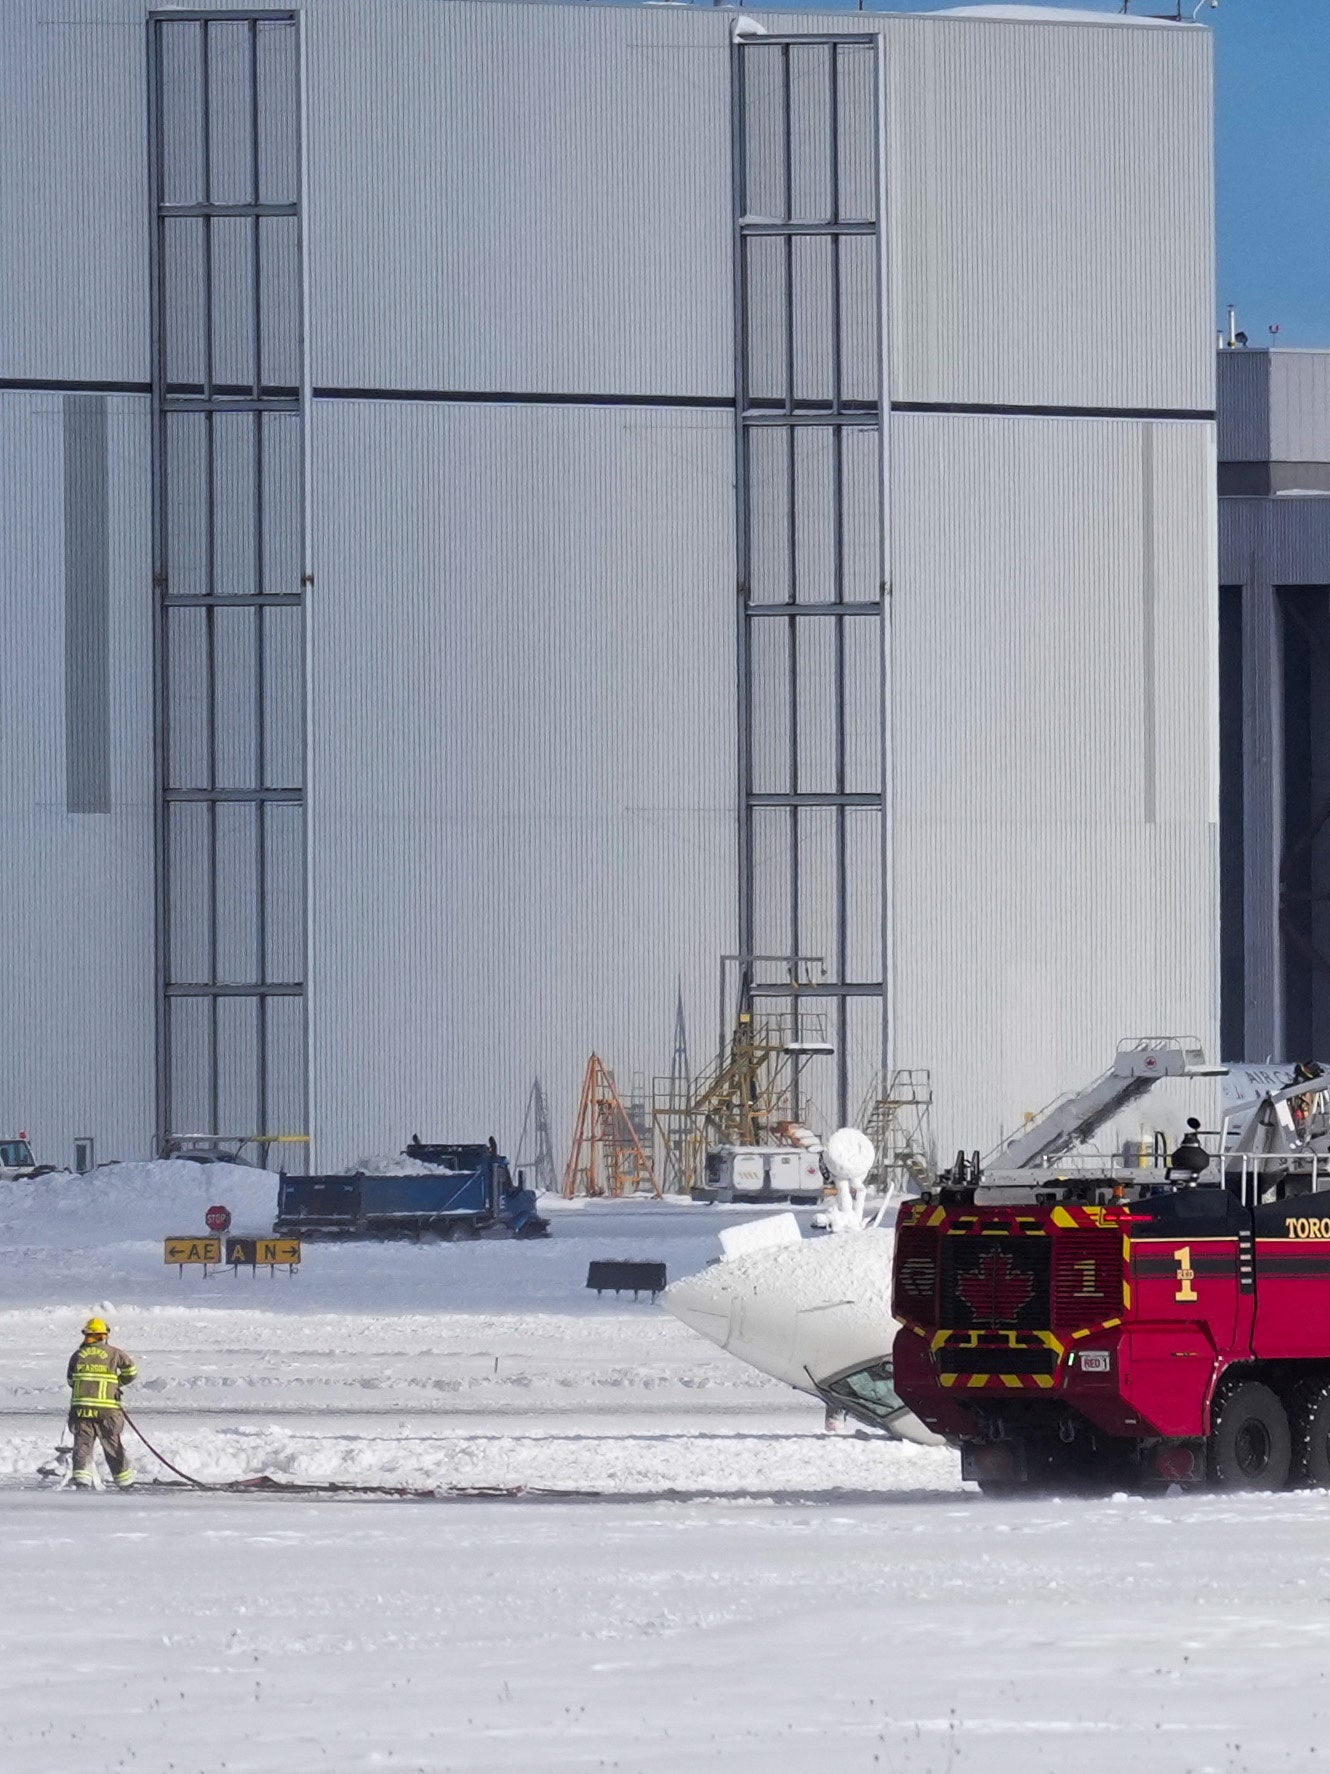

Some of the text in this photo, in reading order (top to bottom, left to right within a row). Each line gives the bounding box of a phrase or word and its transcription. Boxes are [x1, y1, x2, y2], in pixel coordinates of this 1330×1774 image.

[1245, 1070, 1274, 1085] AIR
[206, 1214, 226, 1224] STOP
[188, 1243, 215, 1260] AE
[231, 1244, 277, 1261] A N
[1073, 1259, 1104, 1297] 1
[1174, 1246, 1198, 1301] 1
[1083, 1358, 1108, 1370] RED 1
